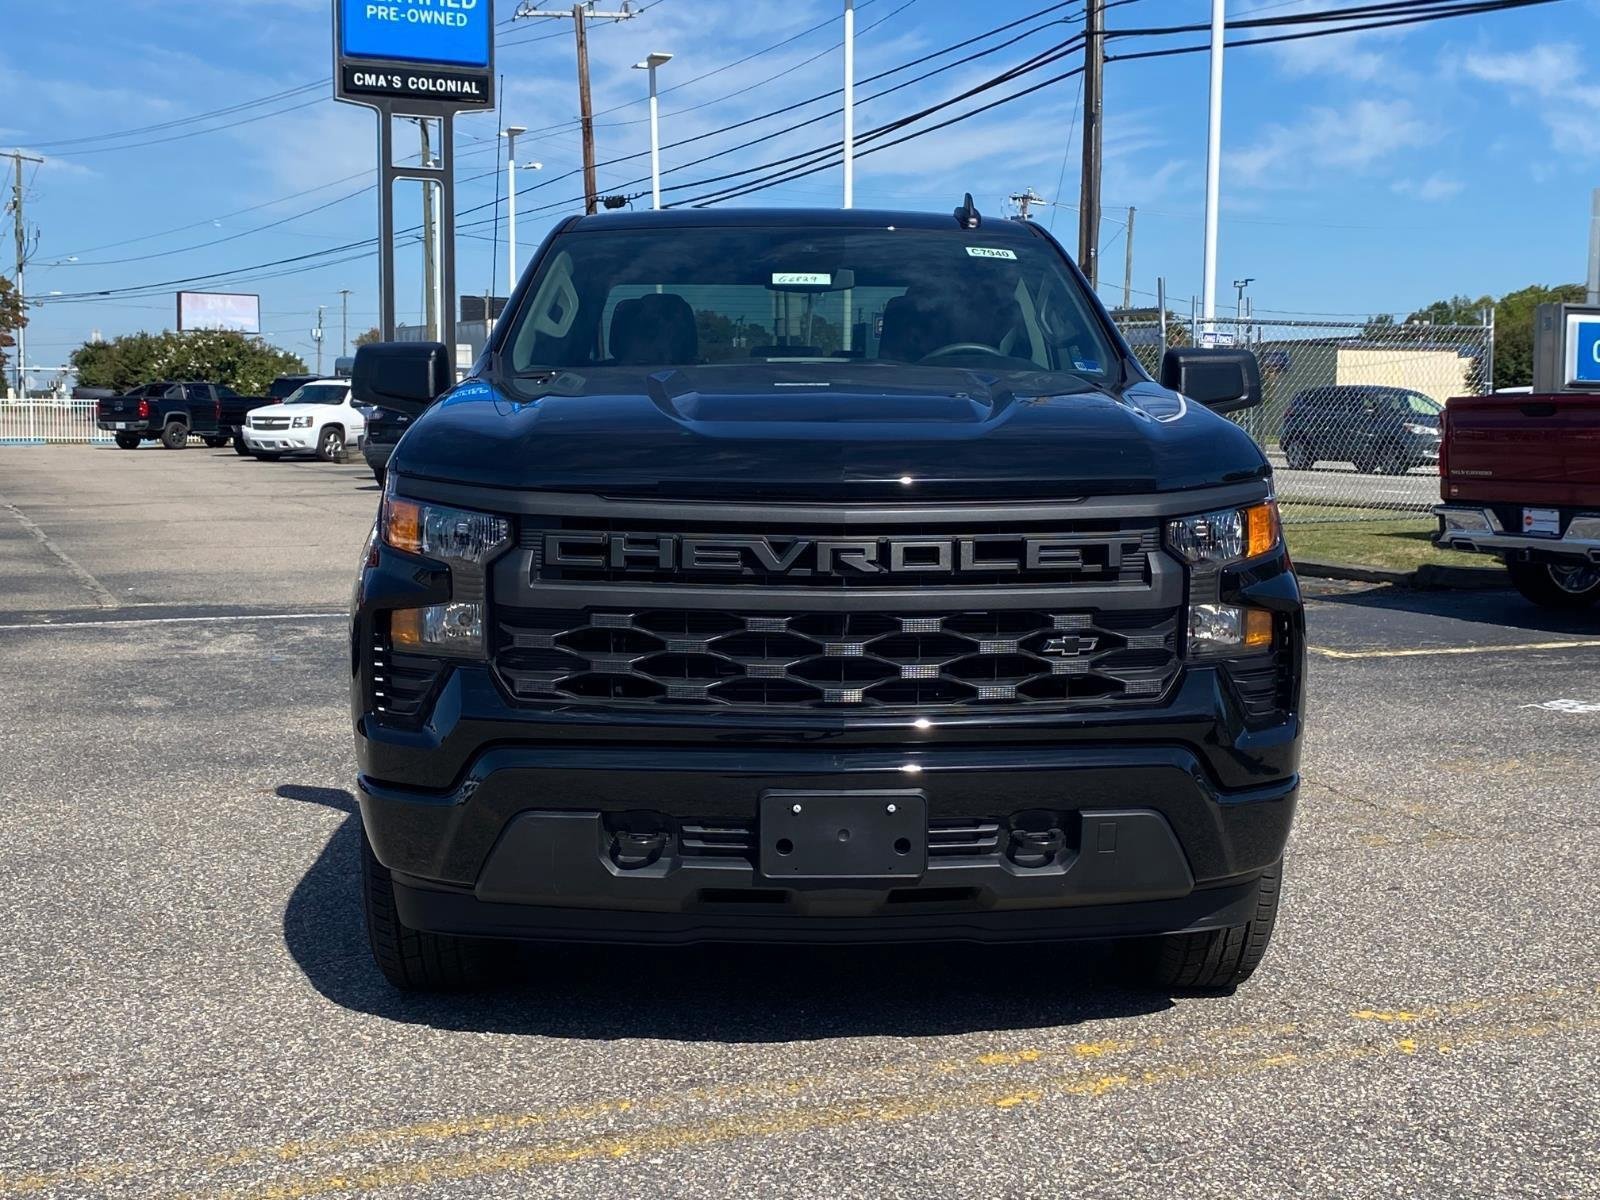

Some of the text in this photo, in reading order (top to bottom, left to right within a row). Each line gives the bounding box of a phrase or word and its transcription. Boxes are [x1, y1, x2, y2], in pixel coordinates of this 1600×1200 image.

[366, 5, 468, 27] PRE-OWNED
[353, 73, 480, 94] CMA'S COLONIAL
[543, 532, 1144, 576] CHEVROLET
